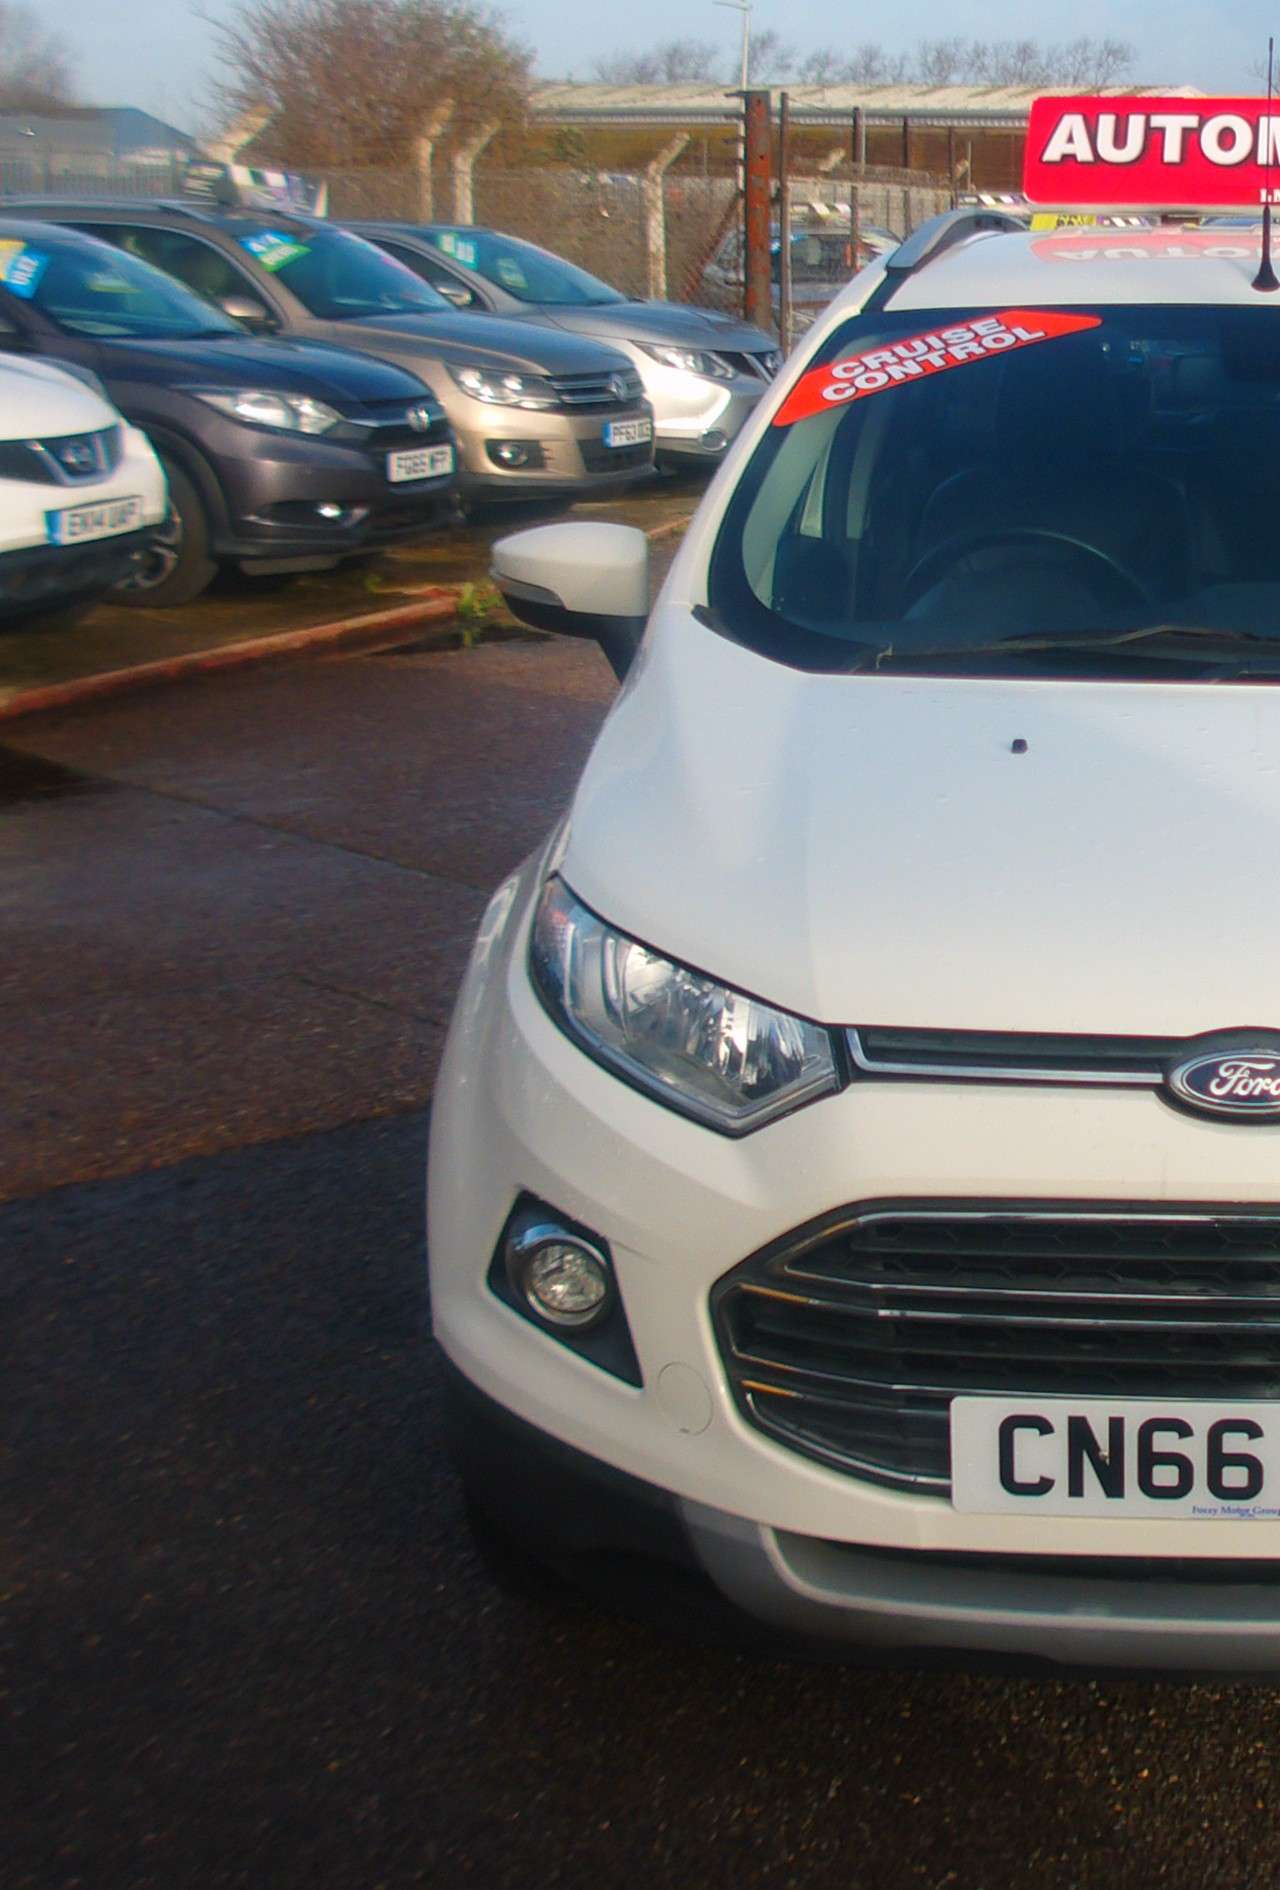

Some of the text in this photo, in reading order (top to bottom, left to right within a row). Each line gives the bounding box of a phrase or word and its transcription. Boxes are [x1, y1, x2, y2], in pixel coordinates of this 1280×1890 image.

[820, 326, 1046, 401] CONTROL
[831, 317, 1007, 380] CRUISE
[998, 1413, 1265, 1500] CN66
